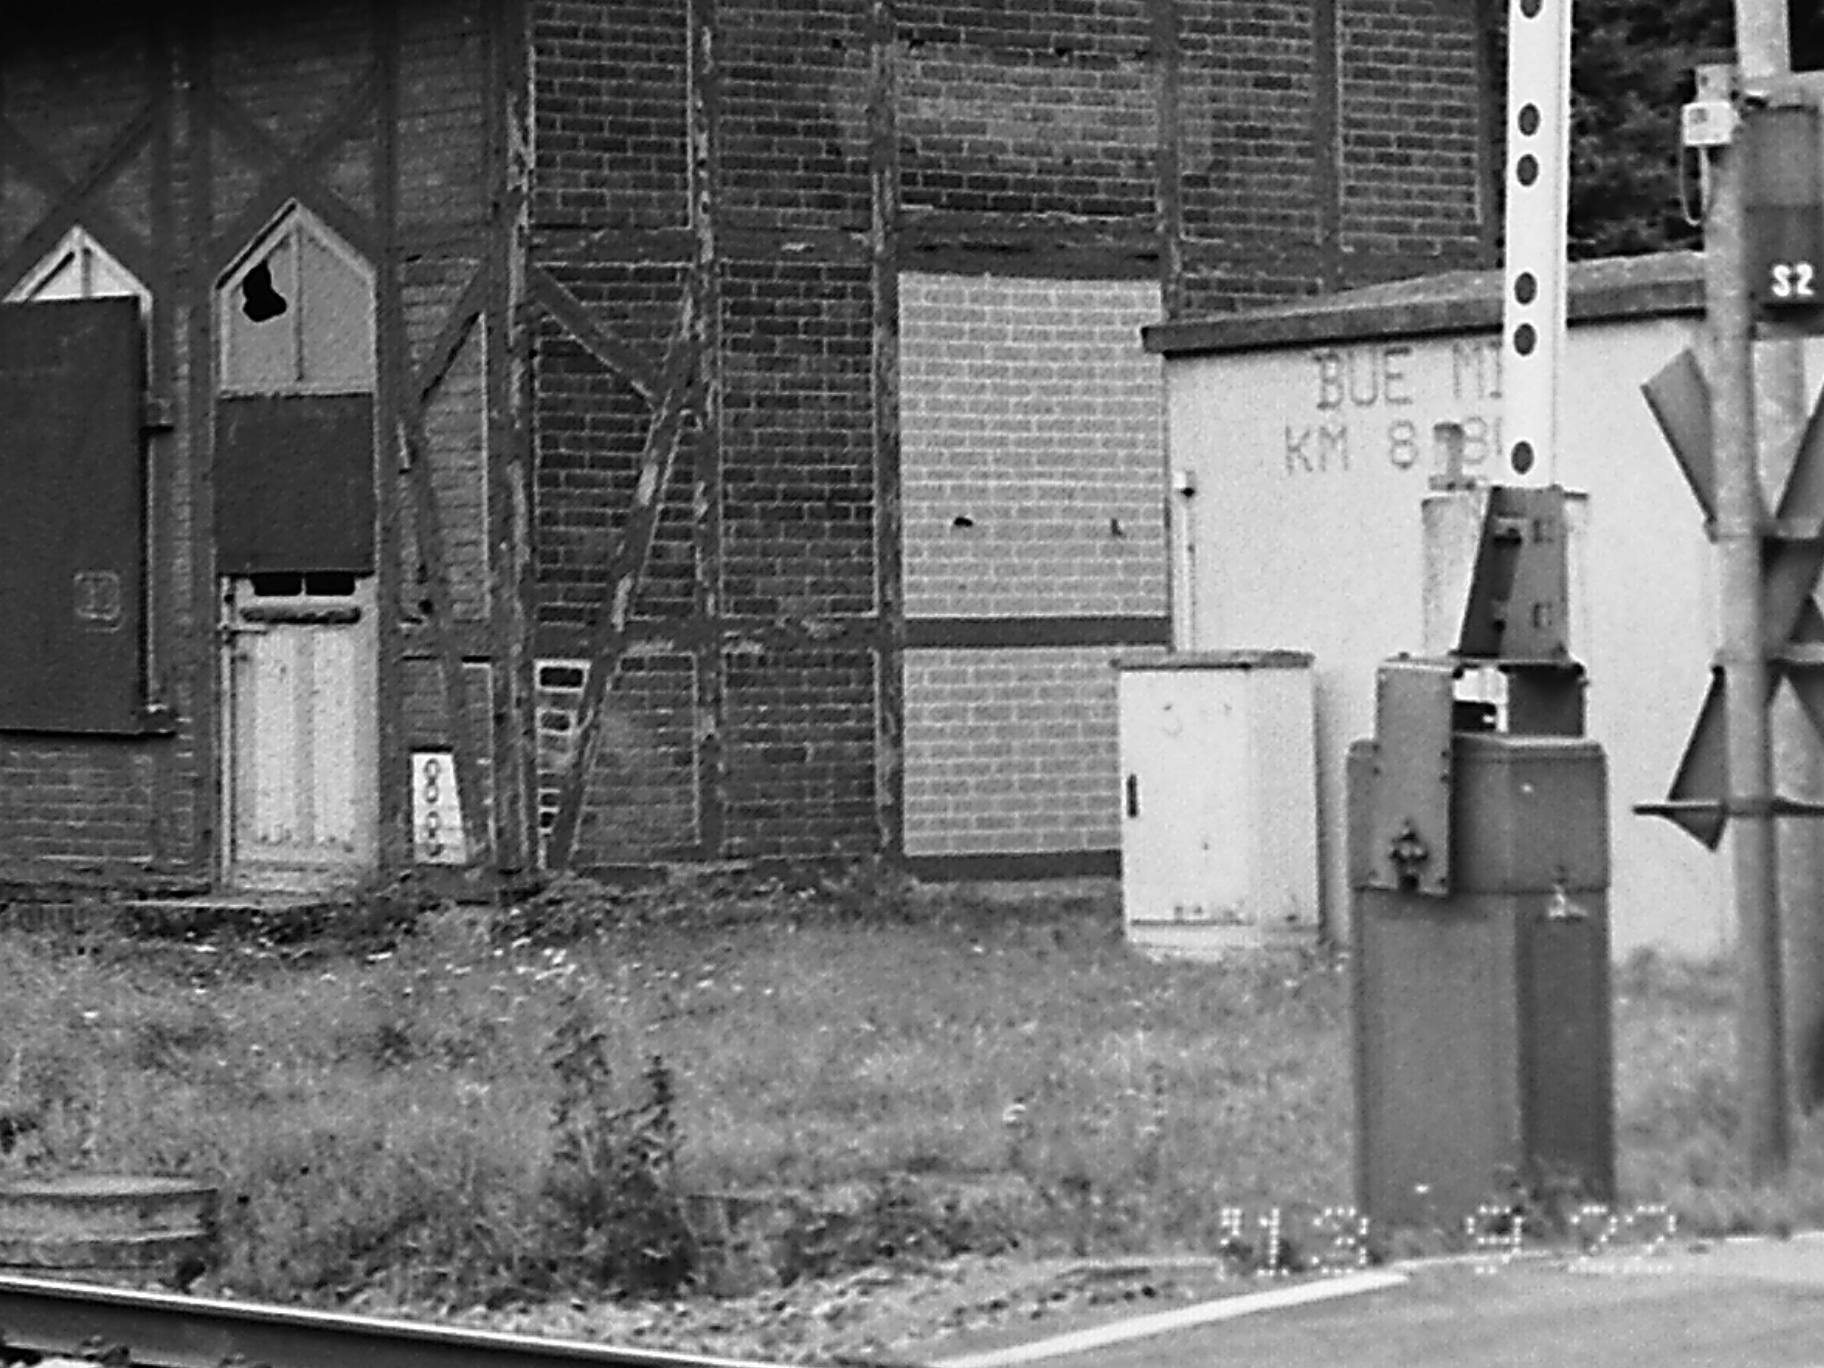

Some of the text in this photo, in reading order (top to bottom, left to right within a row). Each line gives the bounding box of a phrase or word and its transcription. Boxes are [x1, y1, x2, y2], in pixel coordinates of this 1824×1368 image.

[1772, 261, 1814, 298] S2
[1313, 345, 1413, 411] BUE
[1284, 424, 1350, 475] KM
